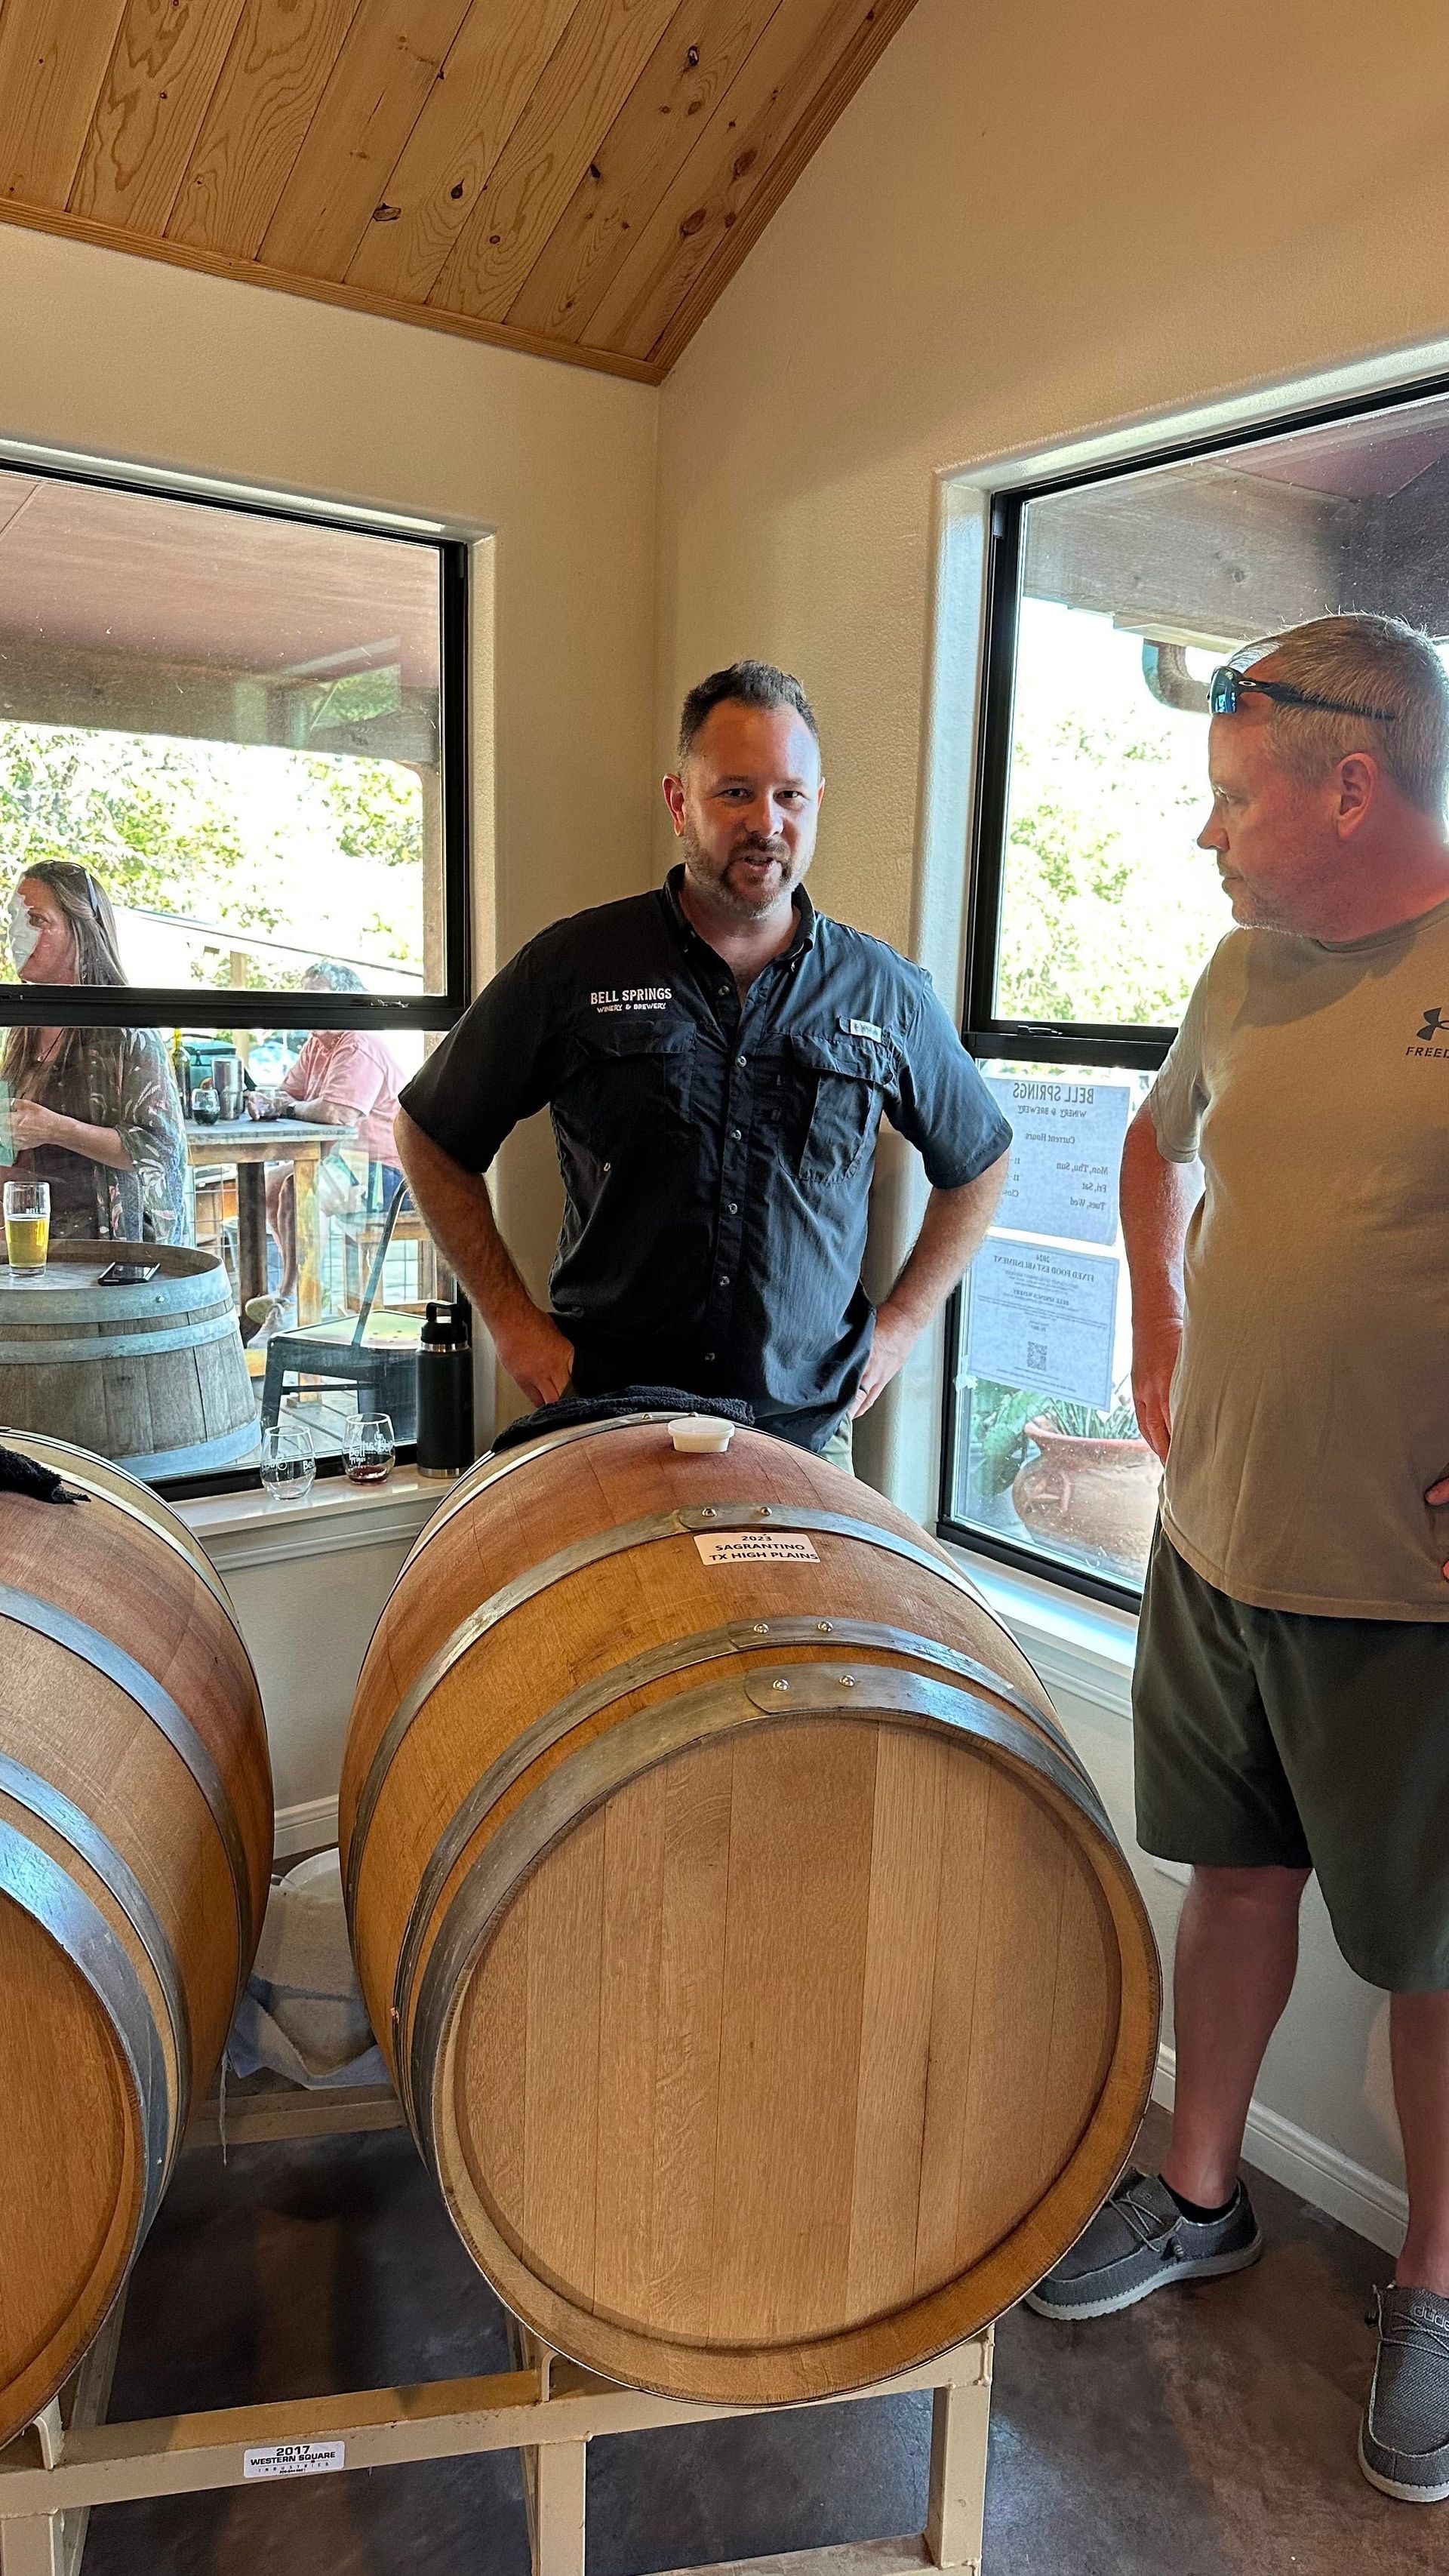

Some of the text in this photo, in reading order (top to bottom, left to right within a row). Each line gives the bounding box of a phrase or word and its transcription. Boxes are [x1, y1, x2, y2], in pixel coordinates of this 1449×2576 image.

[591, 987, 672, 1005] BELL SPRINGS
[597, 1004, 623, 1013] WINERY
[276, 2445, 310, 2456] 2017
[251, 2451, 336, 2466] WESTERN SQUARE
